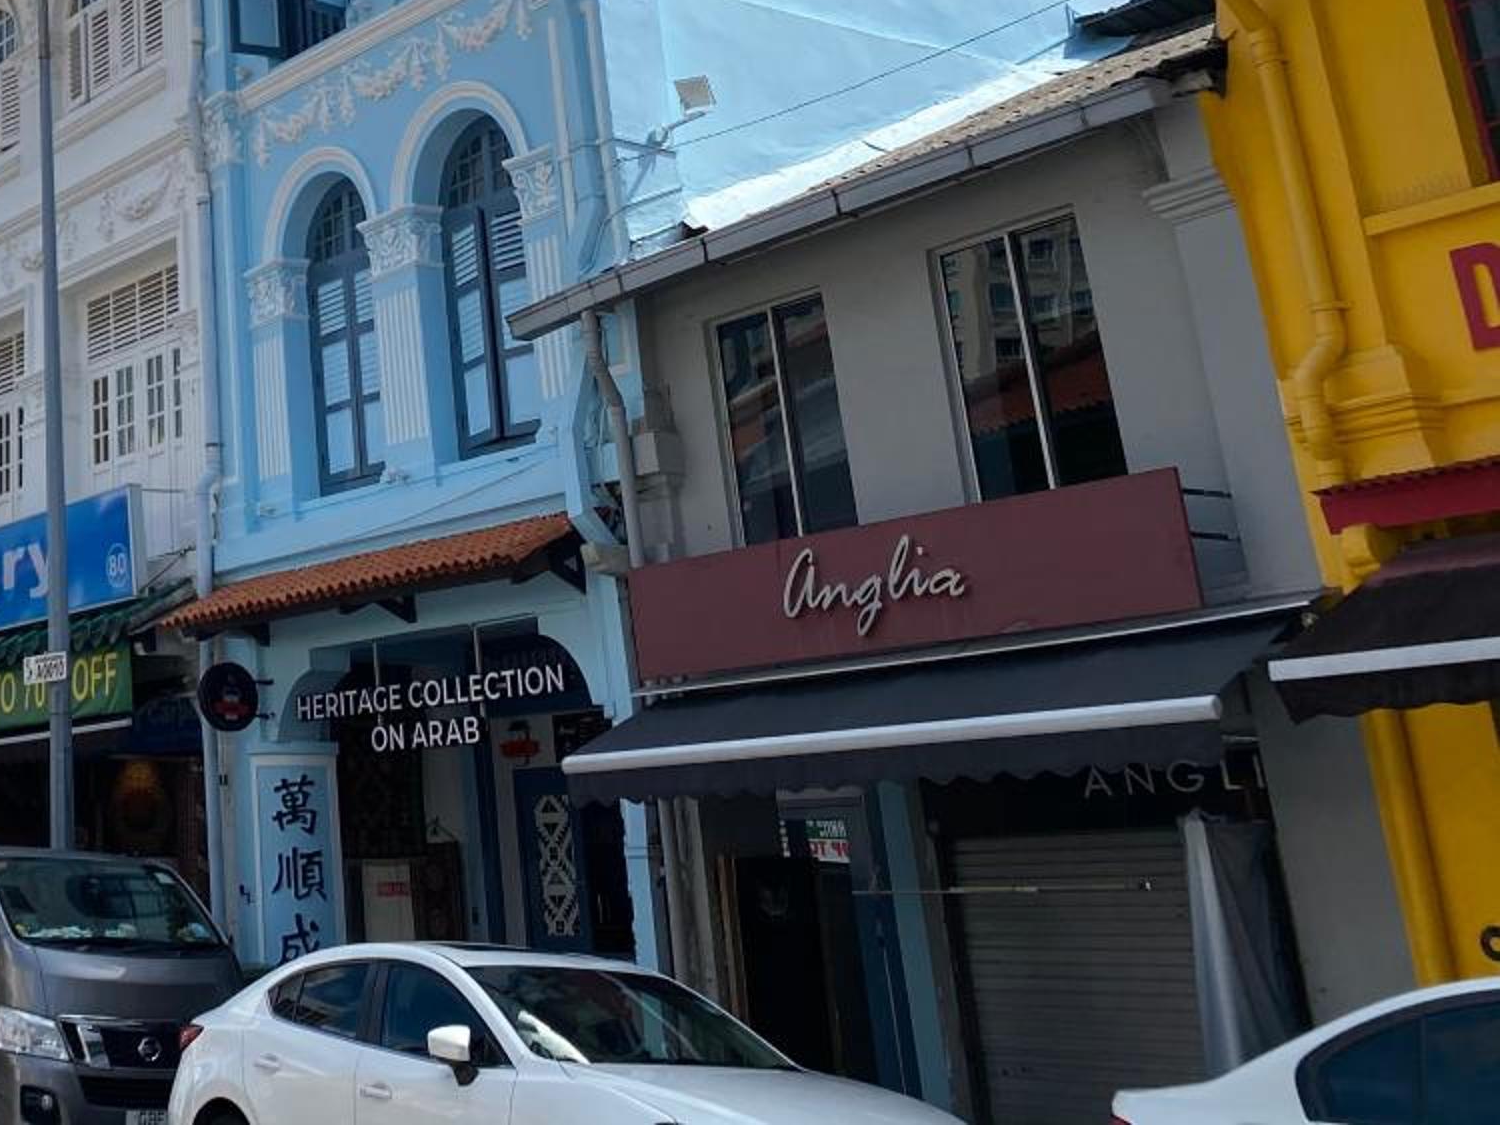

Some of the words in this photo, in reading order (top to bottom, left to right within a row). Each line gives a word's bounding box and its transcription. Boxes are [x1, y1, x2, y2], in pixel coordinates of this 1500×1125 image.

[784, 534, 965, 636] Anglia
[71, 652, 118, 701] OFF
[297, 683, 403, 721] HERITAGE
[407, 663, 565, 709] COLLECTION
[370, 721, 405, 753] ON
[411, 715, 480, 749] ARAB
[271, 773, 328, 969] 萬順成
